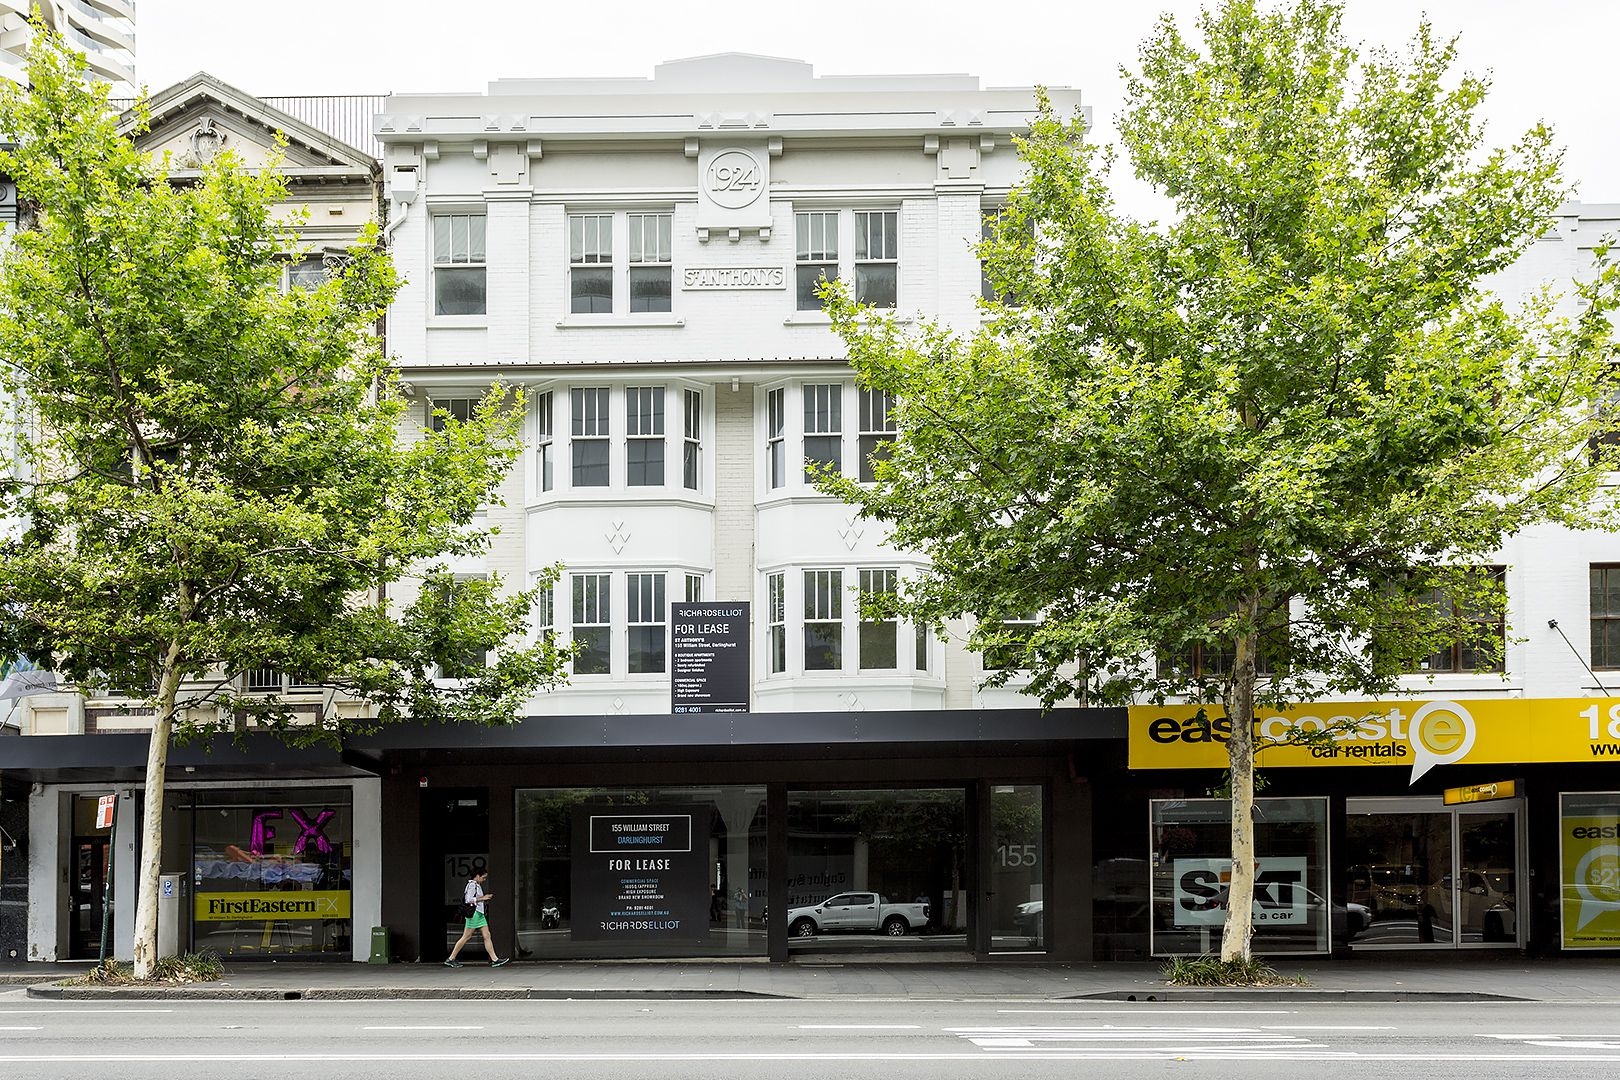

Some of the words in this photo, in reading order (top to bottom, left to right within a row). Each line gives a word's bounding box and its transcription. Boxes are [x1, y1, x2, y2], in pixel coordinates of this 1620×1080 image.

[710, 164, 761, 191] 1924
[679, 609, 742, 617] RICHARDSELLIOT
[675, 624, 695, 635] FOR
[698, 623, 730, 635] LEASE
[1312, 747, 1341, 763] car
[1347, 742, 1406, 763] rentals
[250, 808, 336, 856] FX
[612, 824, 622, 832] 155
[623, 823, 648, 832] WILLIAM
[649, 823, 670, 832] STREET
[618, 836, 664, 845] DARLINGHURST
[997, 844, 1037, 867] 155
[609, 860, 631, 871] FOR
[636, 859, 671, 871] LEASE
[1259, 912, 1268, 920] a
[1272, 911, 1294, 920] car
[601, 920, 680, 931] RICHARDSELLIOT
